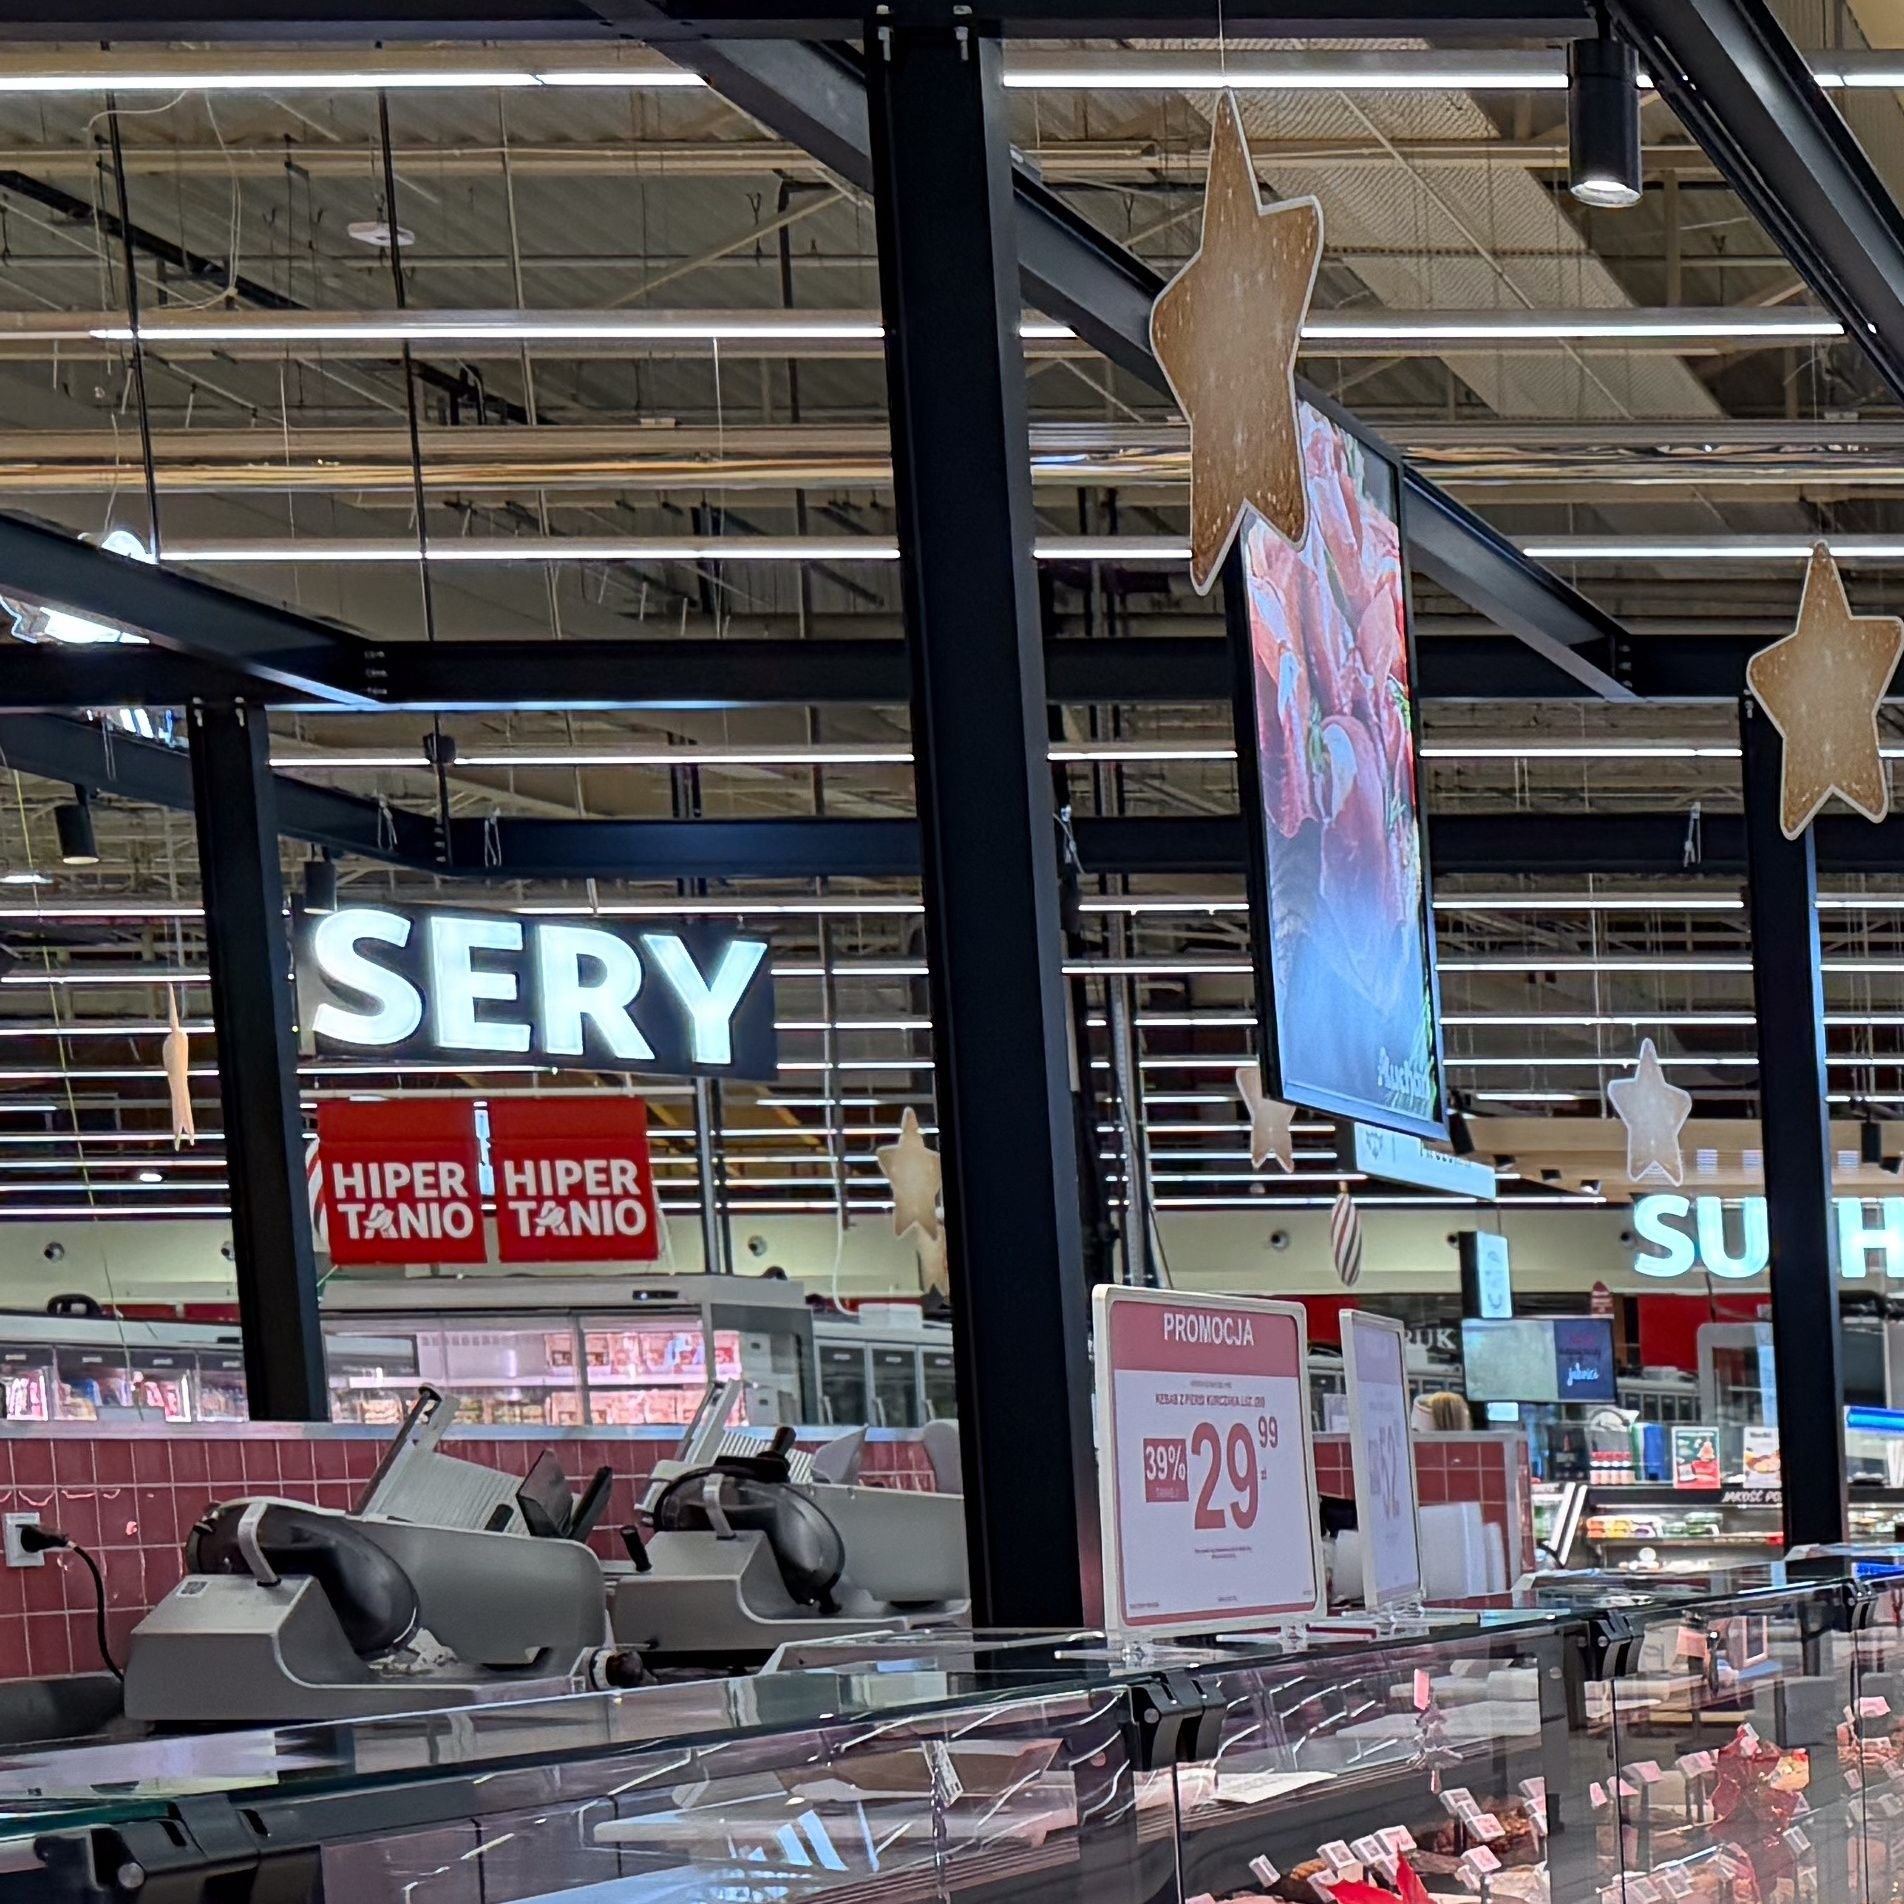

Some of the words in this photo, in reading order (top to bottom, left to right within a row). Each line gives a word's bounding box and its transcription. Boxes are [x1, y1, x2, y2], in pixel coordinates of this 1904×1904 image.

[313, 907, 768, 1066] SERY
[332, 1161, 469, 1200] HIPER
[504, 1158, 642, 1197] HIPER
[337, 1202, 474, 1240] TANIO
[508, 1199, 648, 1238] TANIO
[1163, 1312, 1255, 1346] PROMOCJA
[1145, 1445, 1187, 1481] 39%
[1191, 1422, 1259, 1530] 29
[1258, 1416, 1278, 1448] 99
